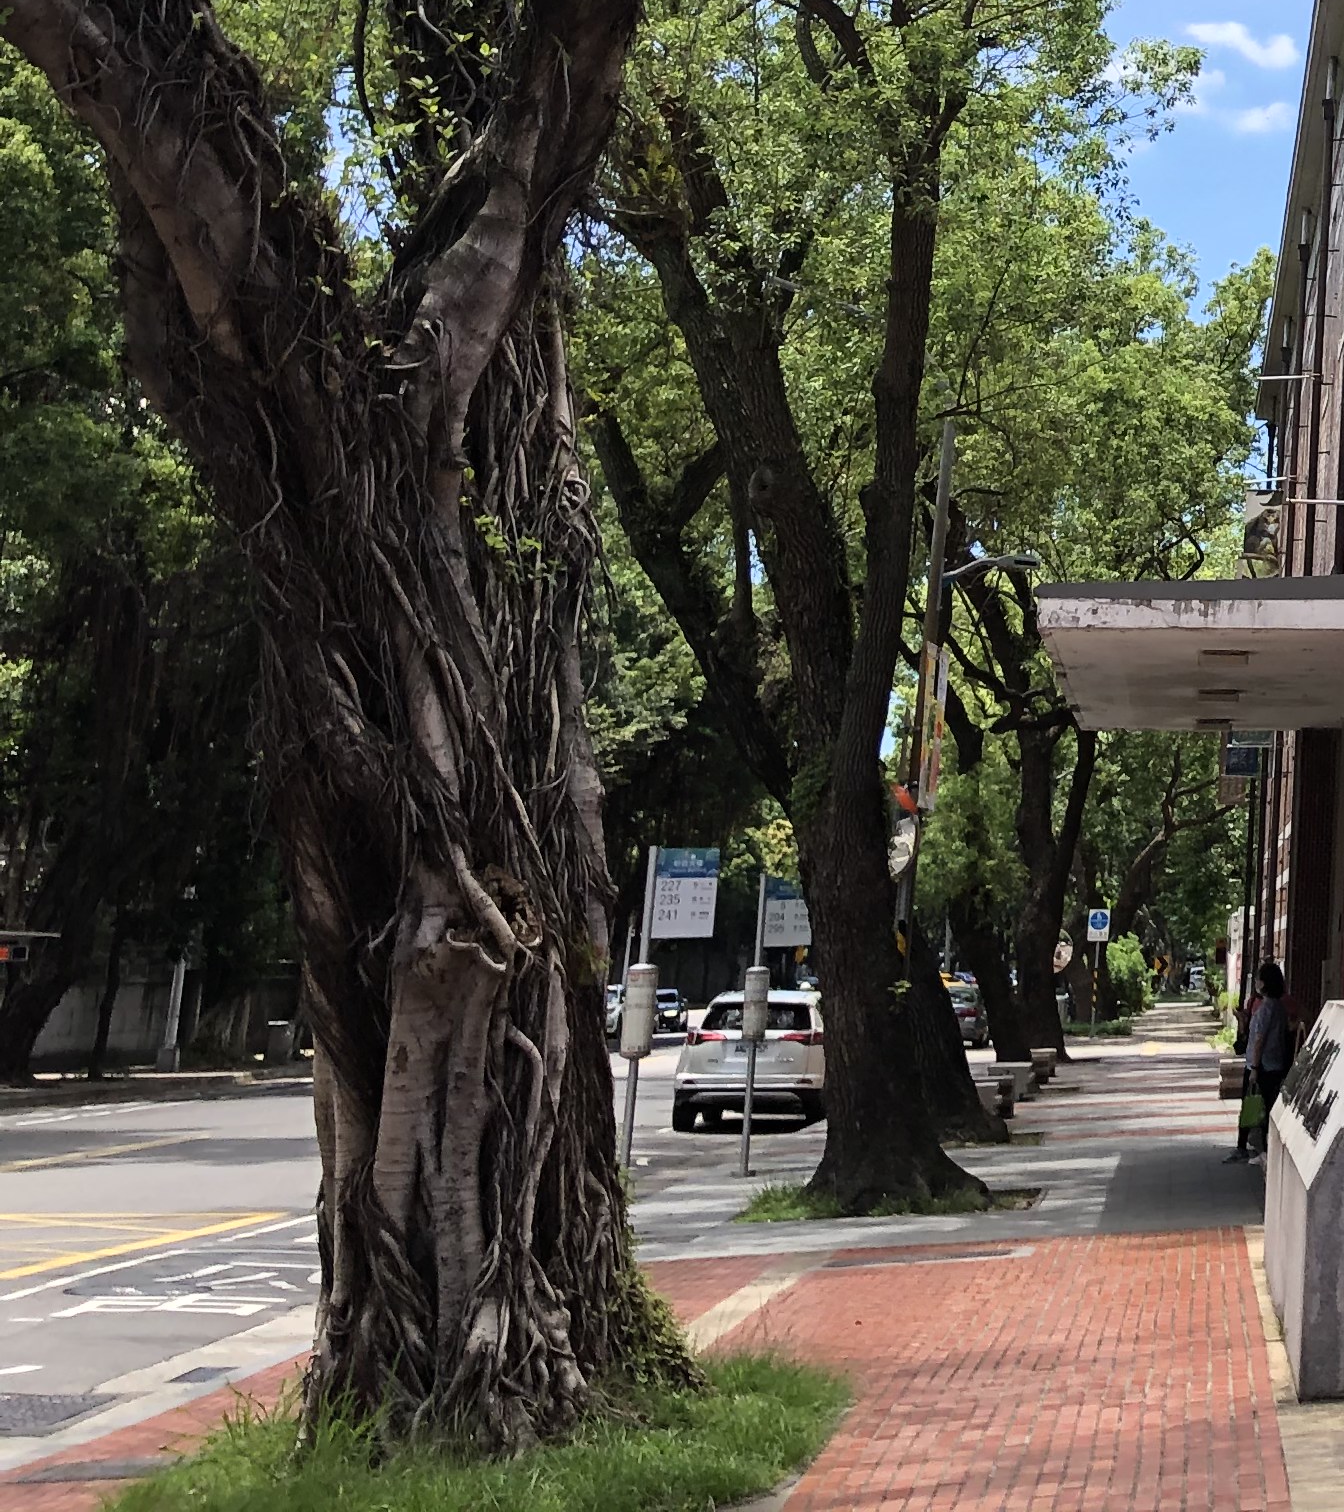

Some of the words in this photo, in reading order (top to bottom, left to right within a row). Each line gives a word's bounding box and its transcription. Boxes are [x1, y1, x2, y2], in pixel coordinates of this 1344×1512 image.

[661, 880, 681, 892] 227
[660, 894, 681, 906] 235
[658, 909, 678, 920] 241
